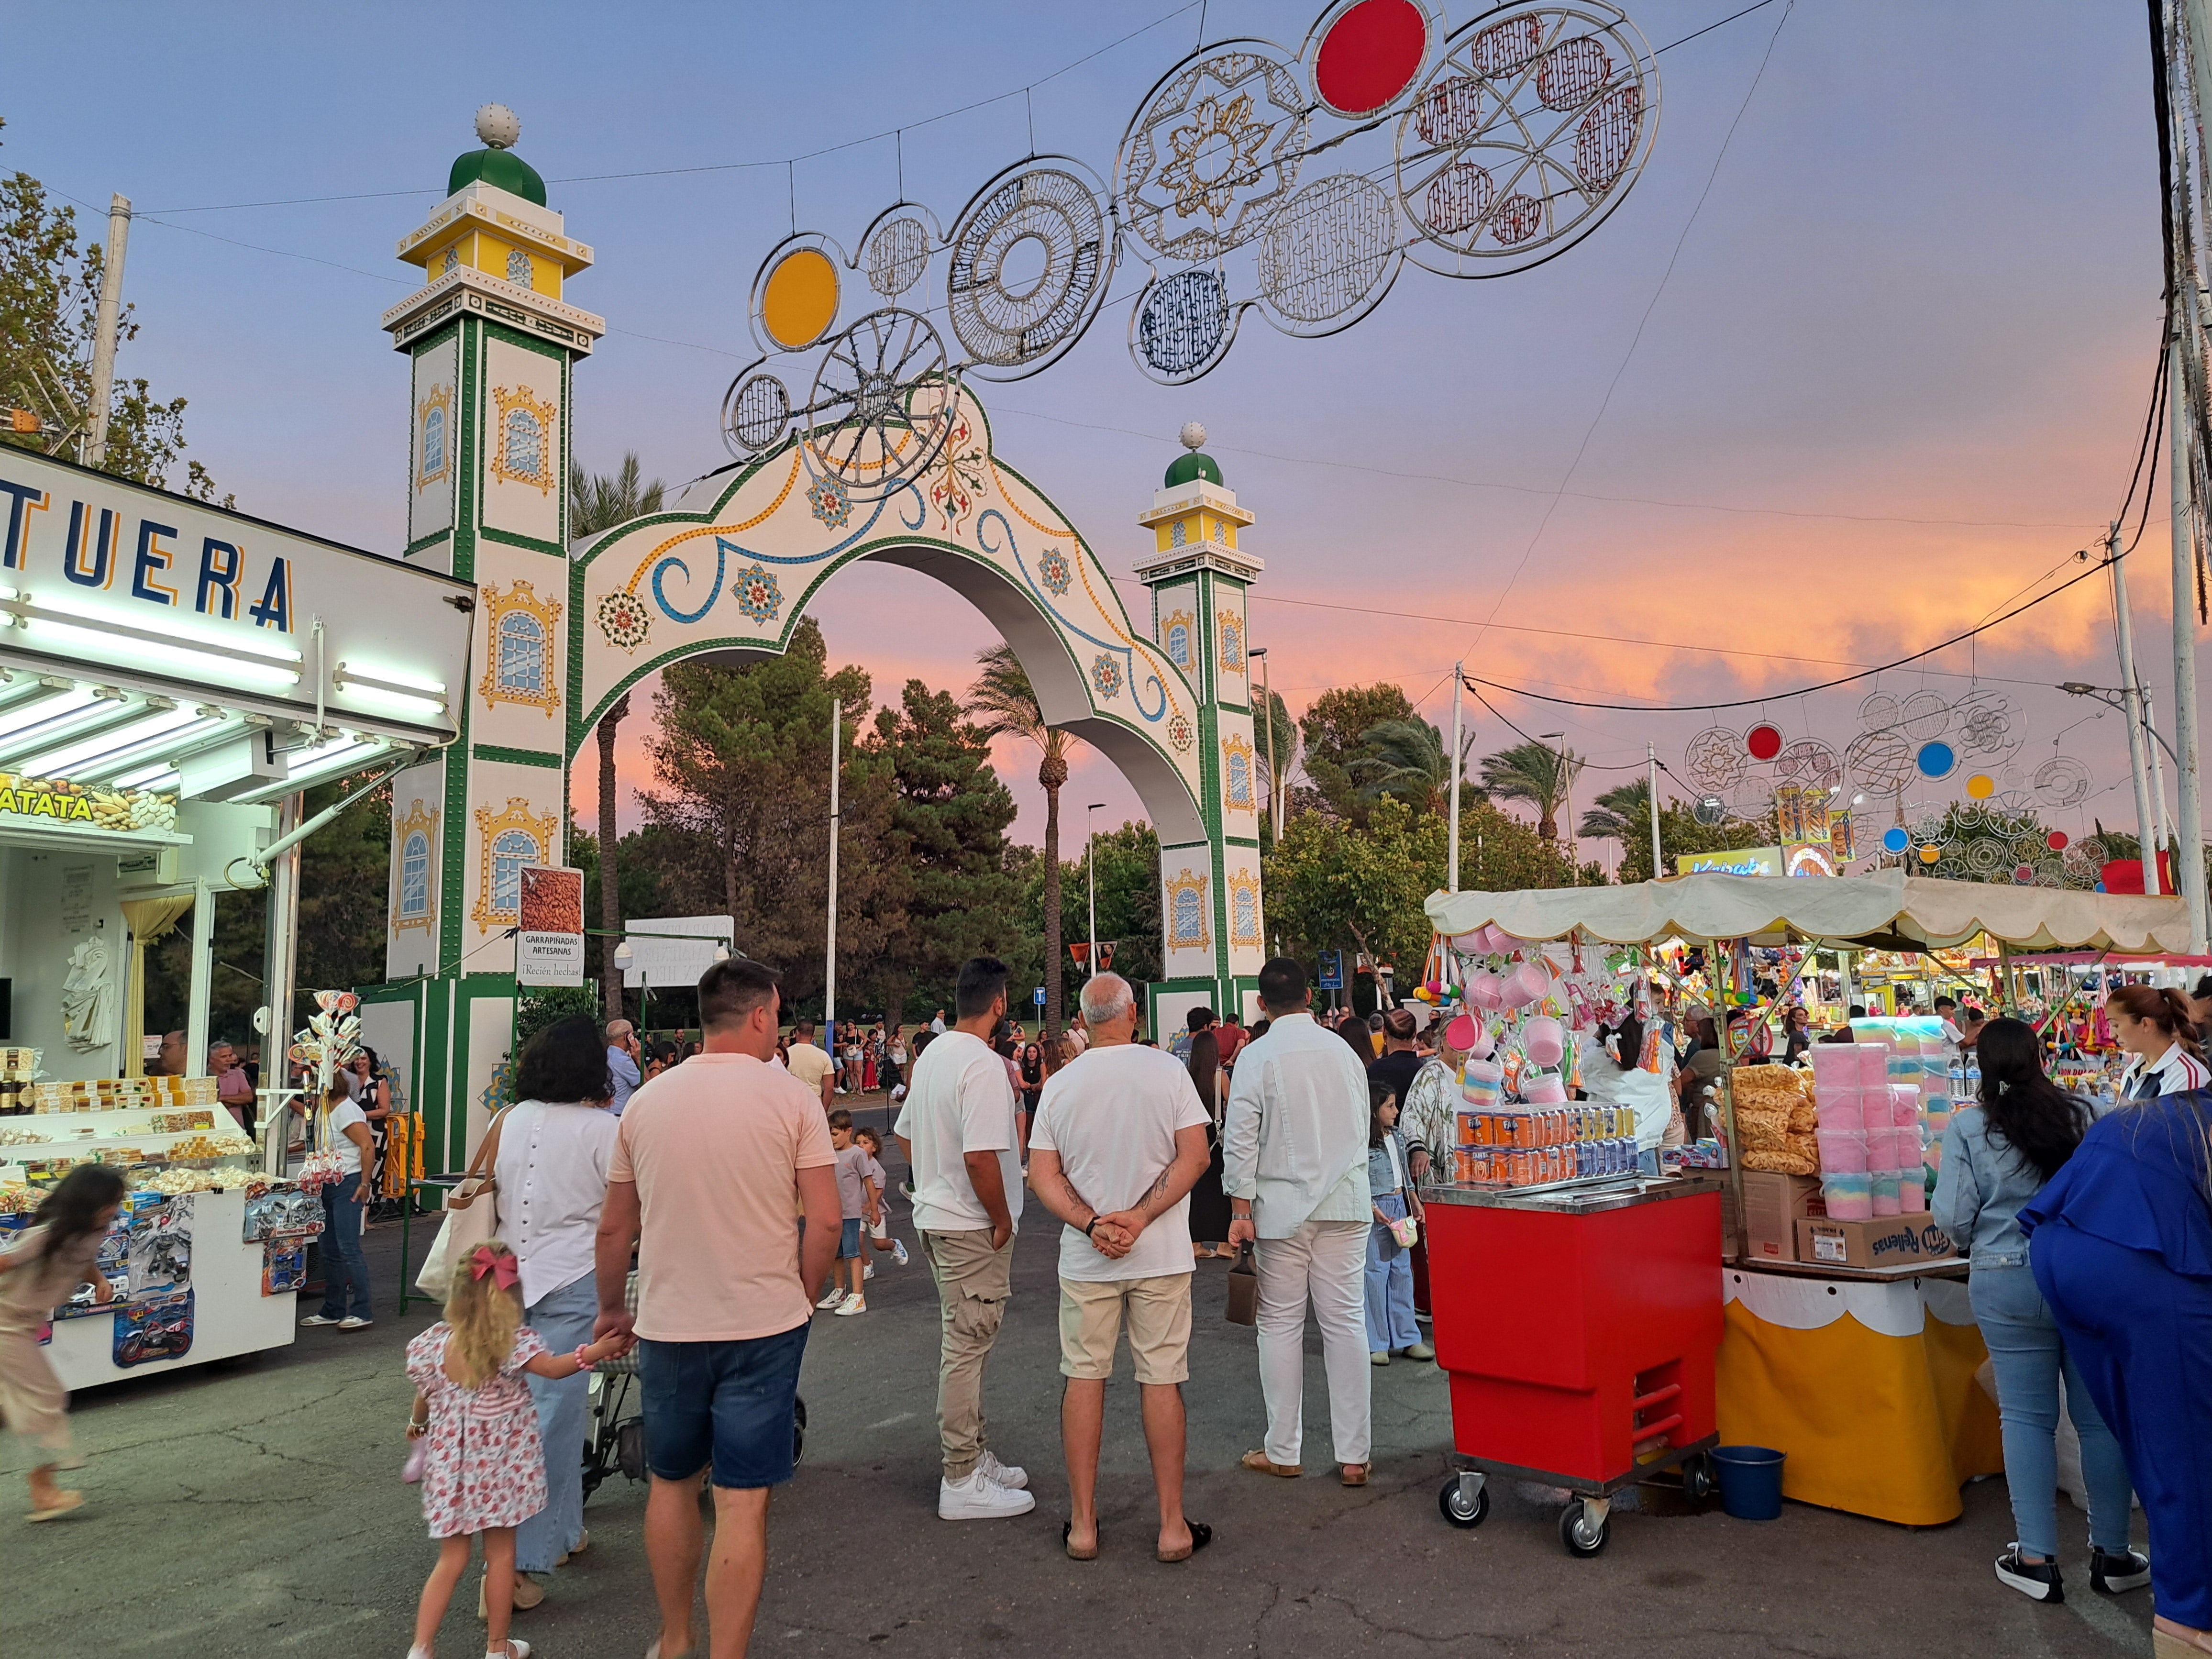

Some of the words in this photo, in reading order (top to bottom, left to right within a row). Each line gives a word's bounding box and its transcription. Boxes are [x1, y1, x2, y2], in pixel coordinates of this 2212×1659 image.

[0, 479, 294, 634] TUERA
[526, 936, 577, 945] GARRAPIÑADAS
[532, 947, 571, 955] ARTESANAS
[523, 964, 551, 975] ¡Recién
[553, 964, 581, 976] hechas!
[1872, 1226, 1920, 1256] Rellenas
